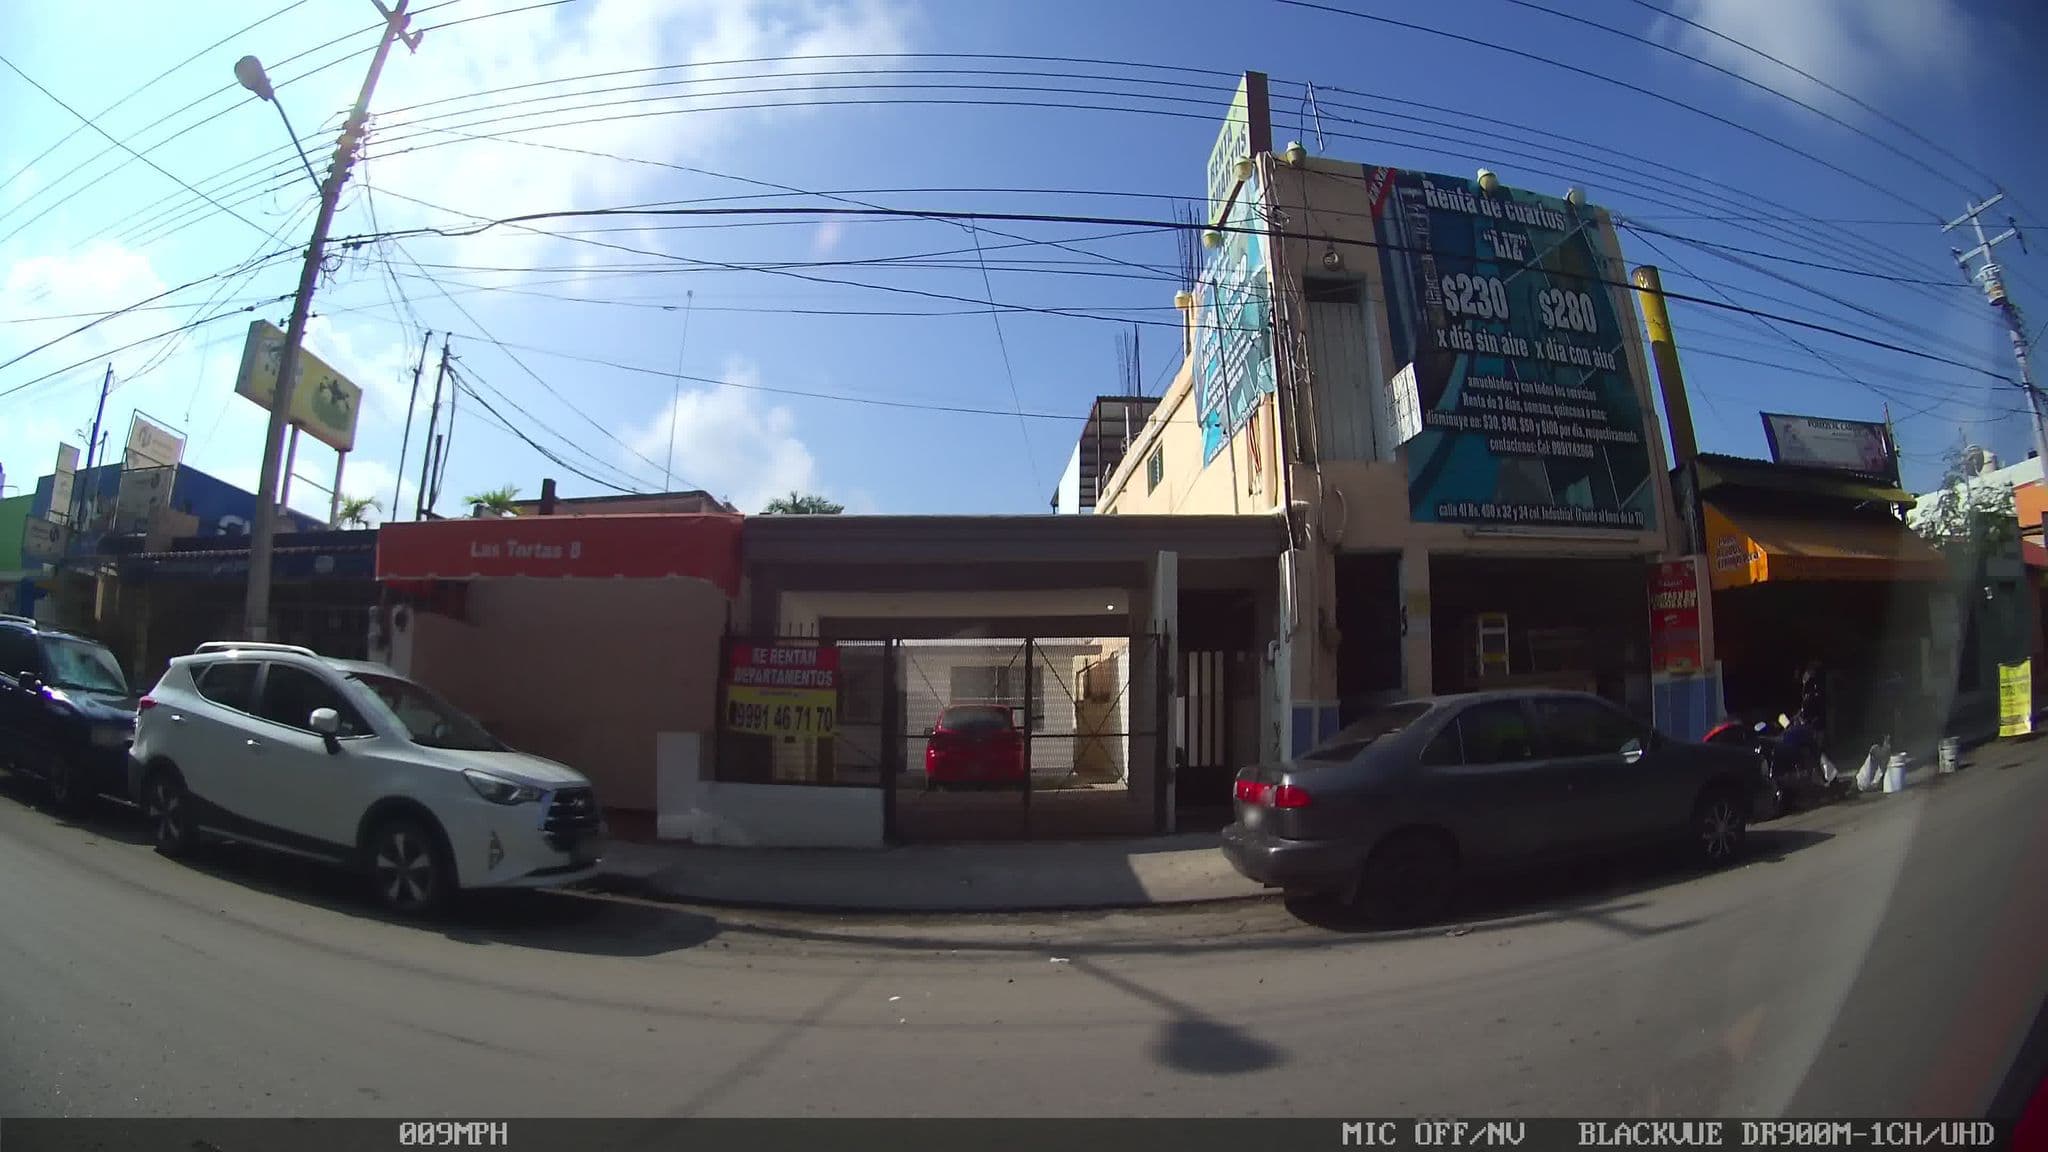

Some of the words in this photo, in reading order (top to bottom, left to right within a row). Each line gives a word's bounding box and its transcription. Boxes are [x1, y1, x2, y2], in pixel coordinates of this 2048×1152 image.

[1423, 180, 1478, 215] Renta
[1480, 197, 1503, 219] de
[1504, 202, 1567, 232] cuartos
[1441, 273, 1509, 320] $230
[1538, 287, 1597, 334] $280
[1437, 327, 1448, 348] x
[1476, 328, 1499, 353] sin
[1535, 340, 1545, 360] x
[1569, 345, 1592, 367] con
[1514, 382, 1520, 396] y
[1521, 381, 1534, 393] con
[1462, 391, 1486, 408] Renta
[506, 539, 563, 559] Tortas
[769, 648, 817, 666] RENTAN
[734, 667, 833, 686] DEPARTAMENTOS
[774, 704, 791, 731] 46
[795, 705, 812, 732] 71
[816, 705, 833, 733] 70
